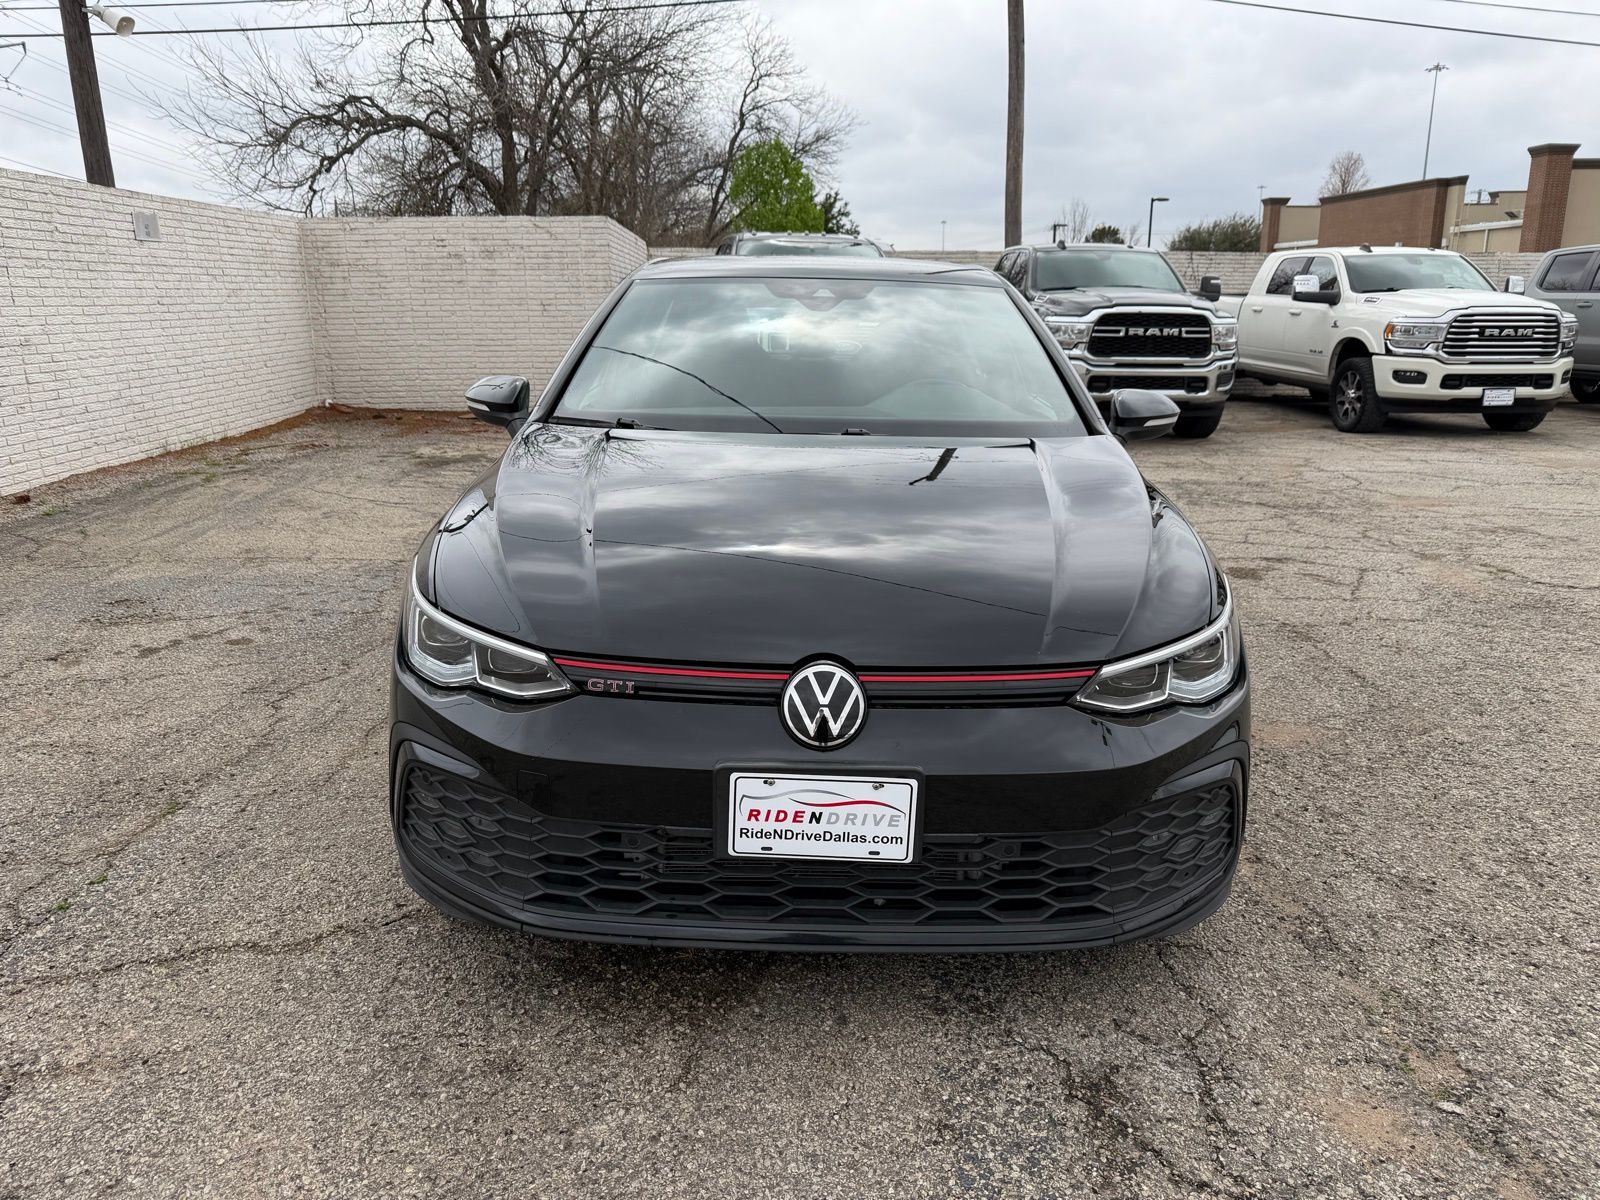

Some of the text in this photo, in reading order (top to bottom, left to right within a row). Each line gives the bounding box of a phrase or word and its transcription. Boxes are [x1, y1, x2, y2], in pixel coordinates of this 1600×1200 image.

[1127, 327, 1180, 337] RAM
[1483, 328, 1534, 337] RAM
[587, 678, 635, 694] GTI
[739, 827, 904, 845] RideNDriveDallas.com
